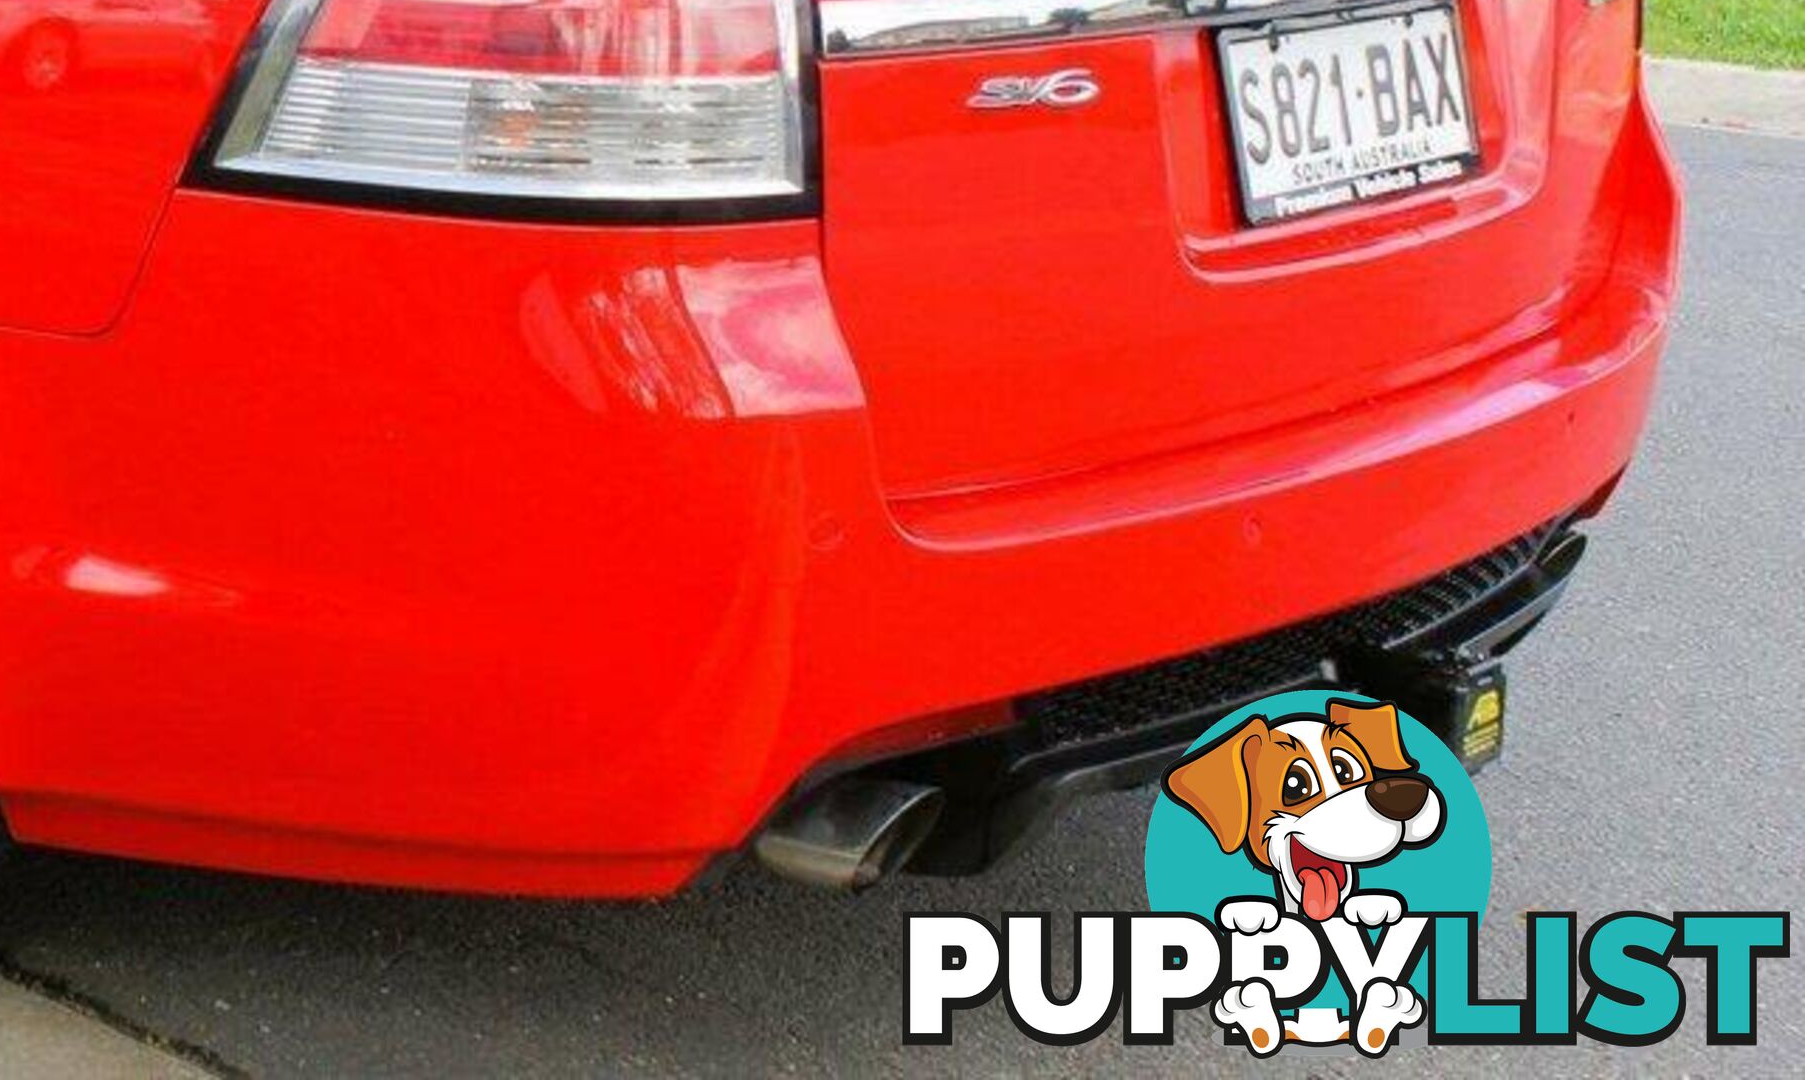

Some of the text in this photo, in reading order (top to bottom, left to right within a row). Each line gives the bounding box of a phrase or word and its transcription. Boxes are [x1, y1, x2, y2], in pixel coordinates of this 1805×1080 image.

[965, 68, 1100, 109] SV6
[1291, 140, 1432, 186] SOUTH AUSTRALIA
